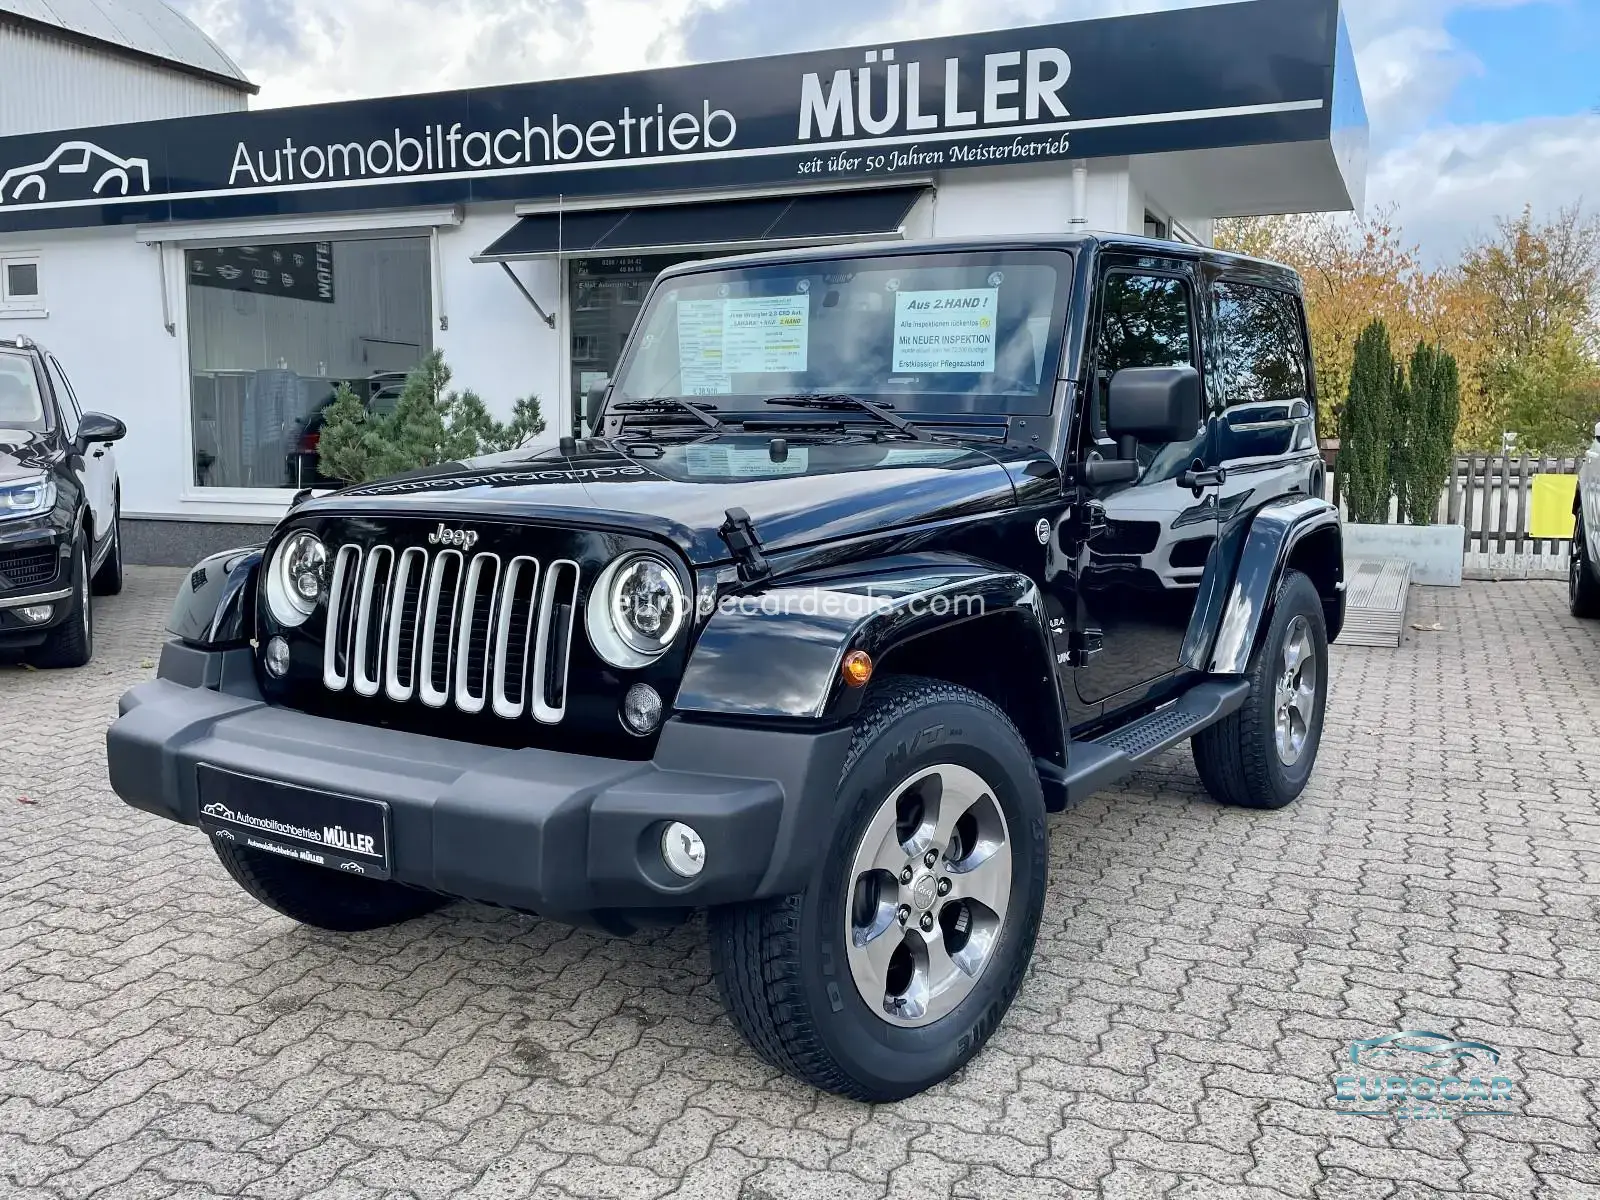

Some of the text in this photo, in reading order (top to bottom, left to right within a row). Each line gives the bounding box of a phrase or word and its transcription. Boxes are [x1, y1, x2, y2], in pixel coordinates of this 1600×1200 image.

[228, 47, 1071, 185] Automobilfachbetrieb MÜLLER
[797, 132, 1070, 174] seit über 50 Jahren Meisterbetrieb
[907, 299, 931, 310] Aus
[933, 297, 980, 309] 2.HAND
[899, 334, 991, 345] Mit NEUER INSPEKTION
[940, 359, 985, 368] Pflegezustand
[428, 523, 479, 551] Jeep
[236, 812, 375, 853] Automobilfachbetrieb MÜLLER
[248, 839, 325, 865] Automobilfachbetrieb MÜLLER
